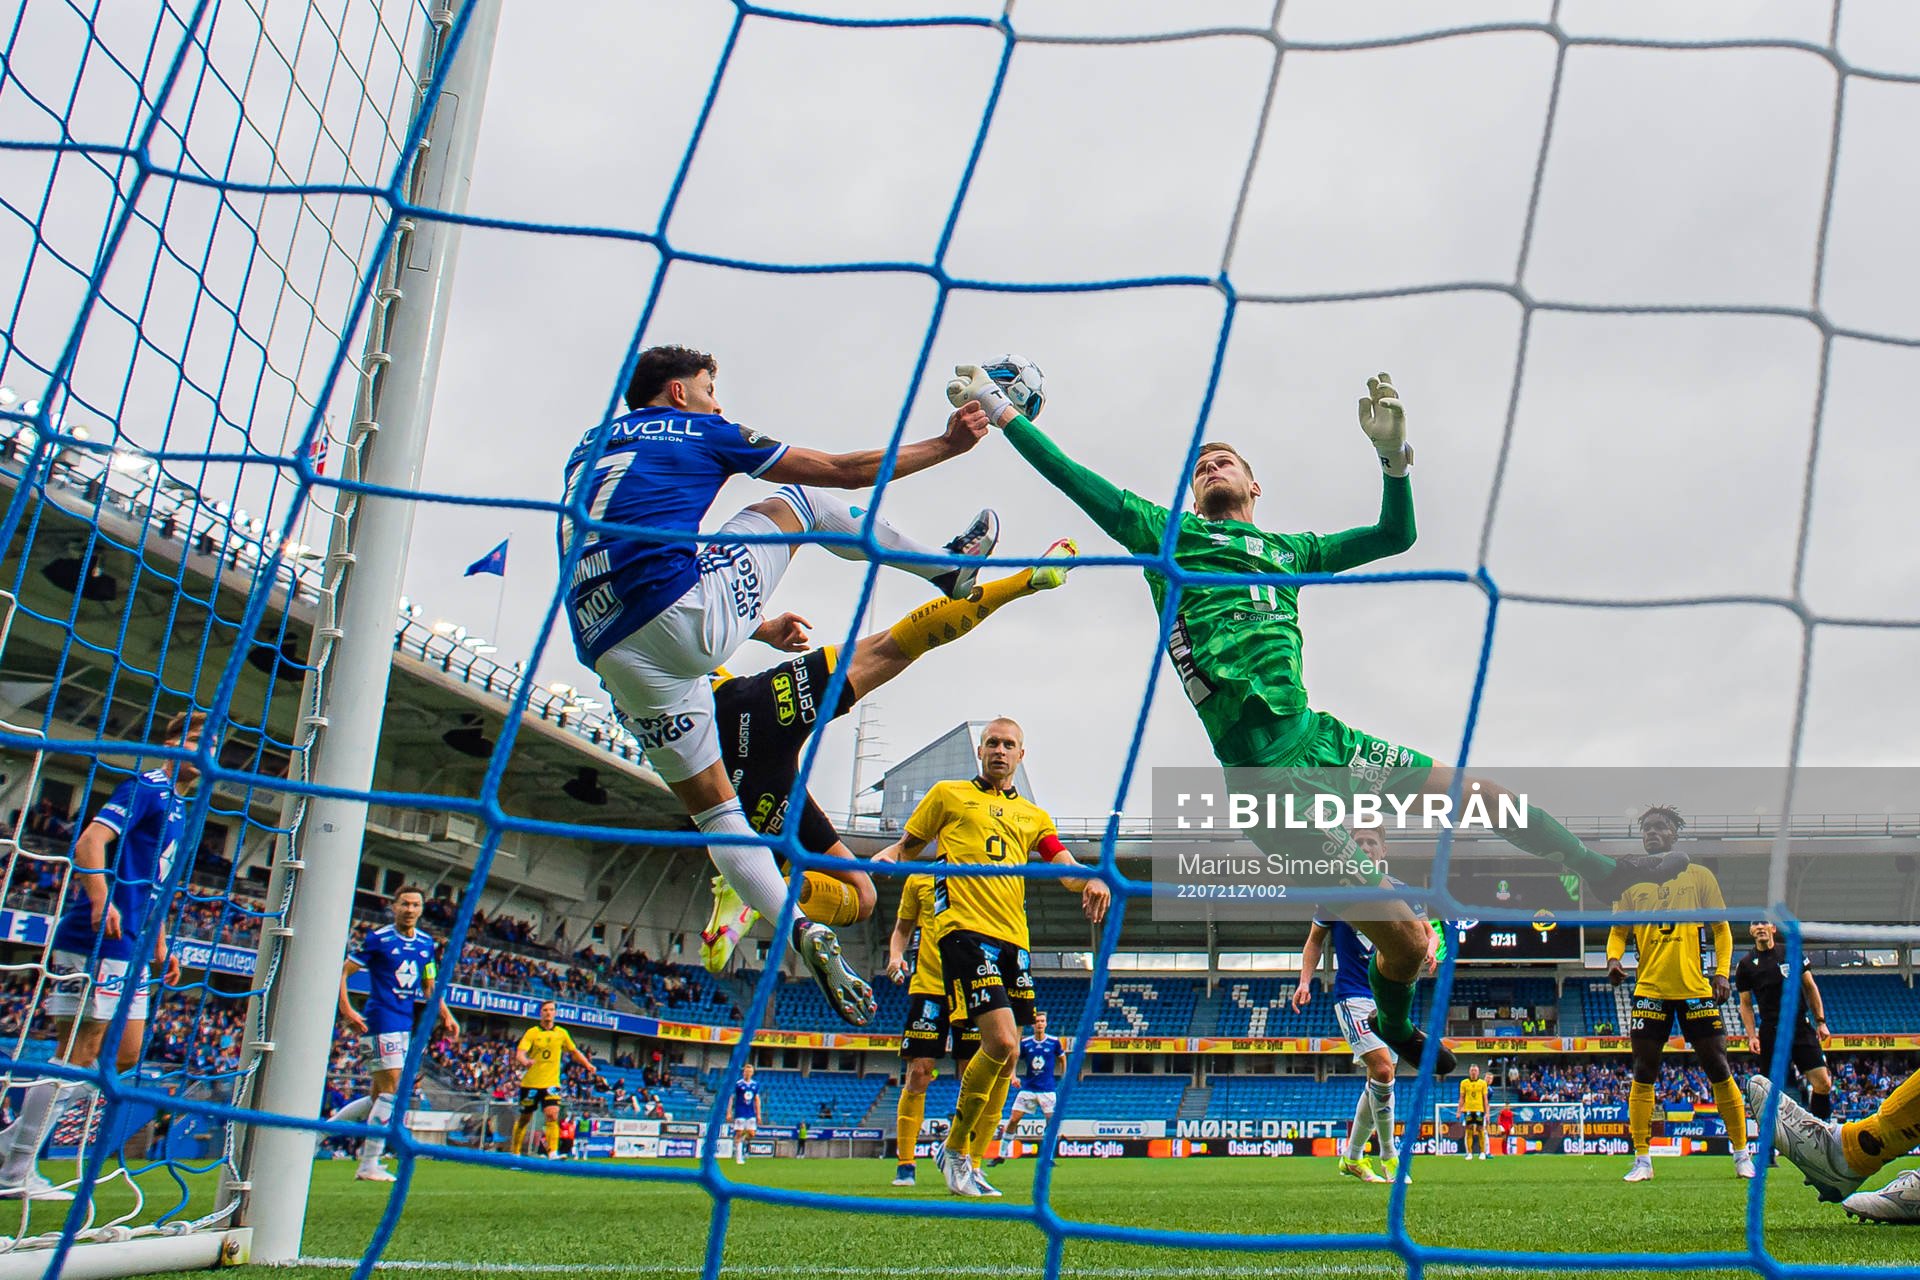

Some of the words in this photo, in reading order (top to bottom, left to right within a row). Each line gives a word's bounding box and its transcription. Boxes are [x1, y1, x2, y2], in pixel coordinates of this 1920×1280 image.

[576, 583, 617, 630] MOT
[772, 674, 796, 721] EAB
[792, 657, 817, 725] cernera
[737, 712, 751, 758] LOGISTICS
[1490, 933, 1517, 947] 37:31
[1176, 1119, 1254, 1138] MØRE
[1261, 1119, 1337, 1138] DRIFT
[1673, 1126, 1704, 1136] KPMG
[1058, 1140, 1093, 1156] Oskar
[1093, 1141, 1124, 1159] Sylte
[1228, 1140, 1263, 1156] Oskar
[1263, 1141, 1294, 1158] Sylte
